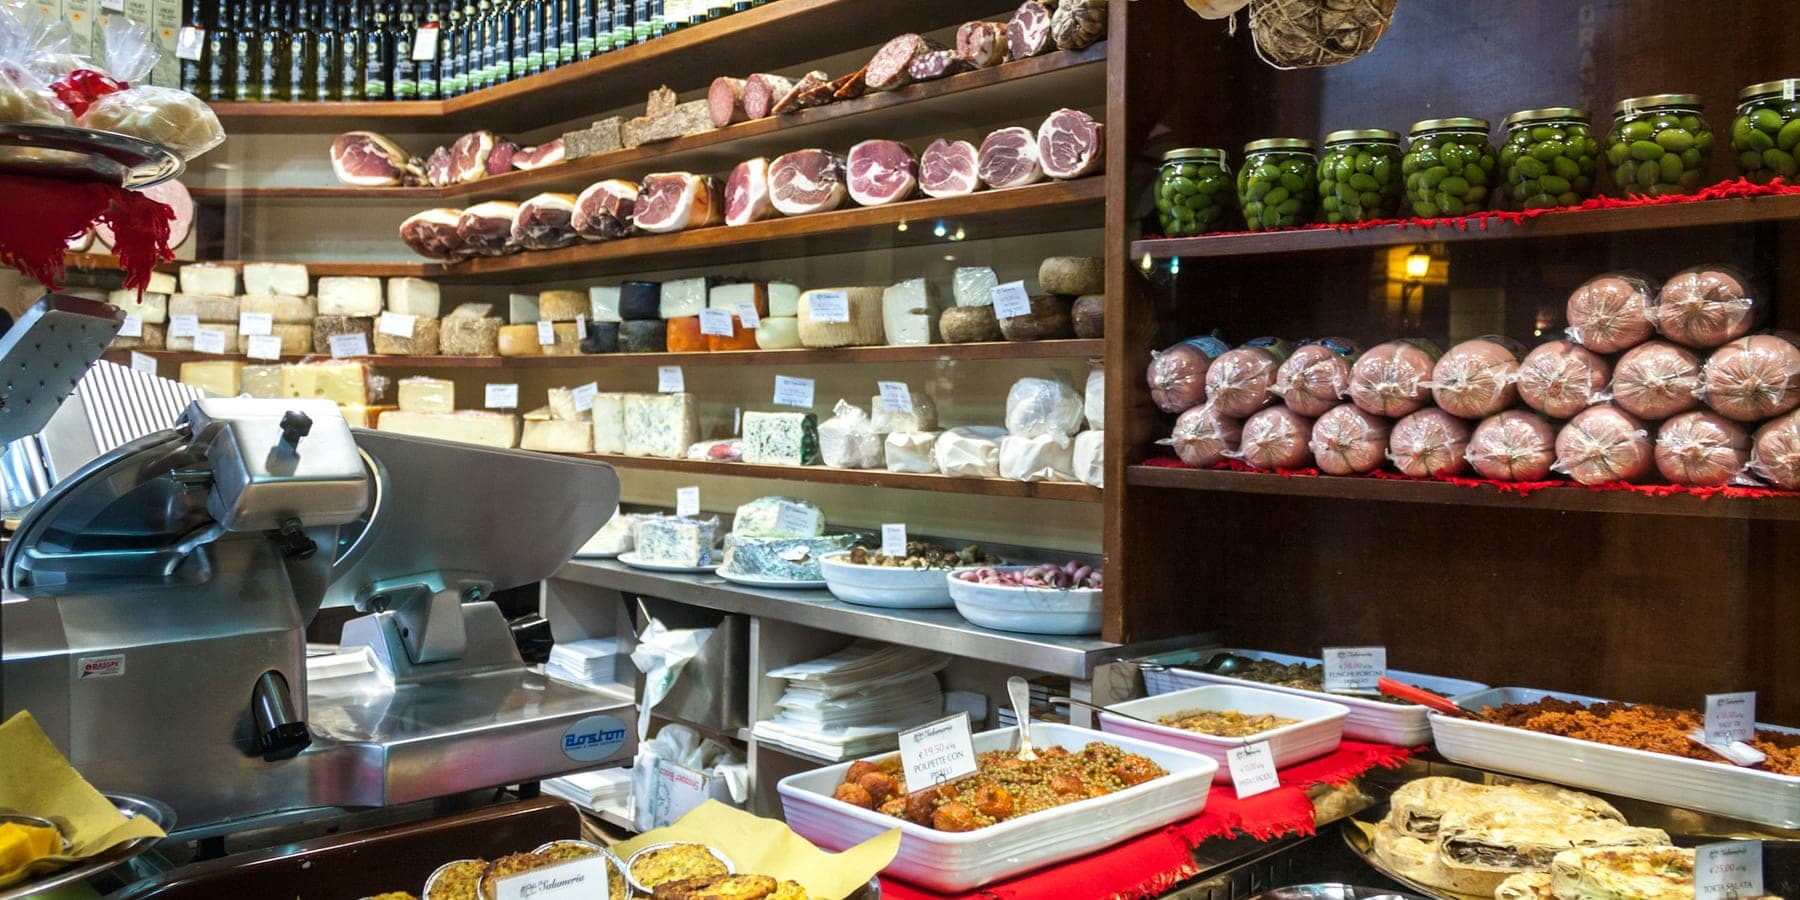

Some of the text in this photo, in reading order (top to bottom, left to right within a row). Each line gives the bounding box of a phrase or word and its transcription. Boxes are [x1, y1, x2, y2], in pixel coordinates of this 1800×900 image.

[565, 729, 625, 747] Boston
[914, 750, 964, 773] POLPETTE CON
[538, 874, 585, 891] Salumeria
